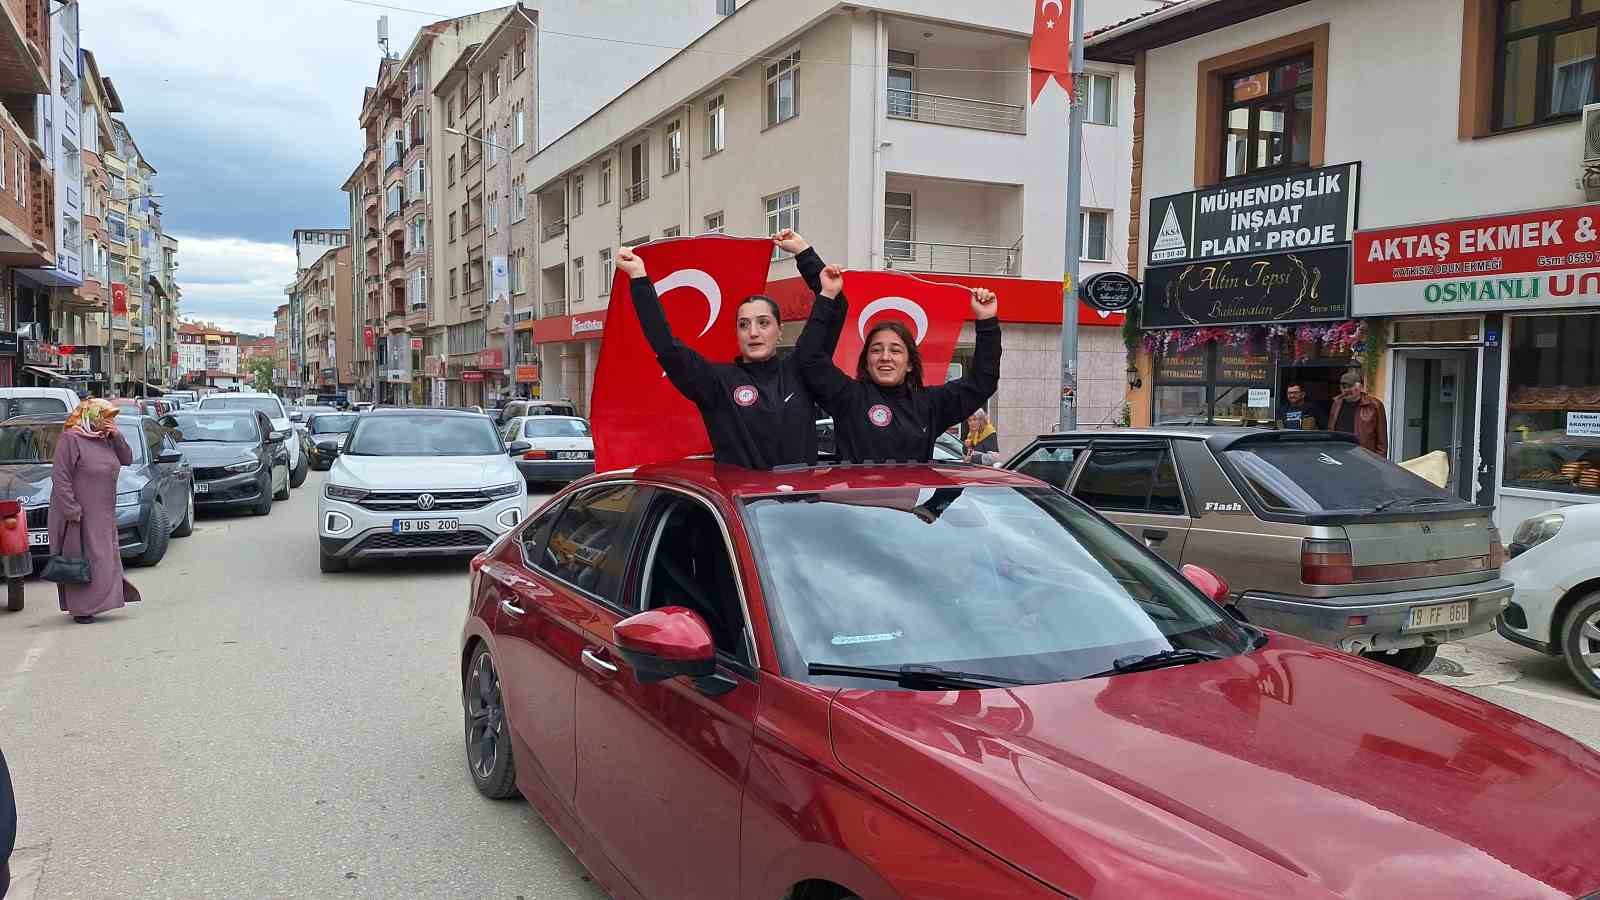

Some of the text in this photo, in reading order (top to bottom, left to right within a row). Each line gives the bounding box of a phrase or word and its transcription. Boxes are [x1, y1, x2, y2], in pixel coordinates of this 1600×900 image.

[1200, 172, 1341, 213] MÜHENDİSLİK
[1231, 204, 1302, 233] İNŞAAT
[1201, 234, 1249, 256] PLAN
[1267, 224, 1336, 249] PROJE
[1368, 216, 1597, 261] AKTAŞ EKMEK &
[1245, 261, 1292, 297] Tepsi
[1434, 262, 1461, 275] ODUN
[1424, 276, 1540, 302] OSMANLI
[1205, 502, 1242, 511] Flash
[400, 520, 457, 531] 19 US 200
[1411, 608, 1423, 626] 19
[1430, 607, 1442, 624] FF
